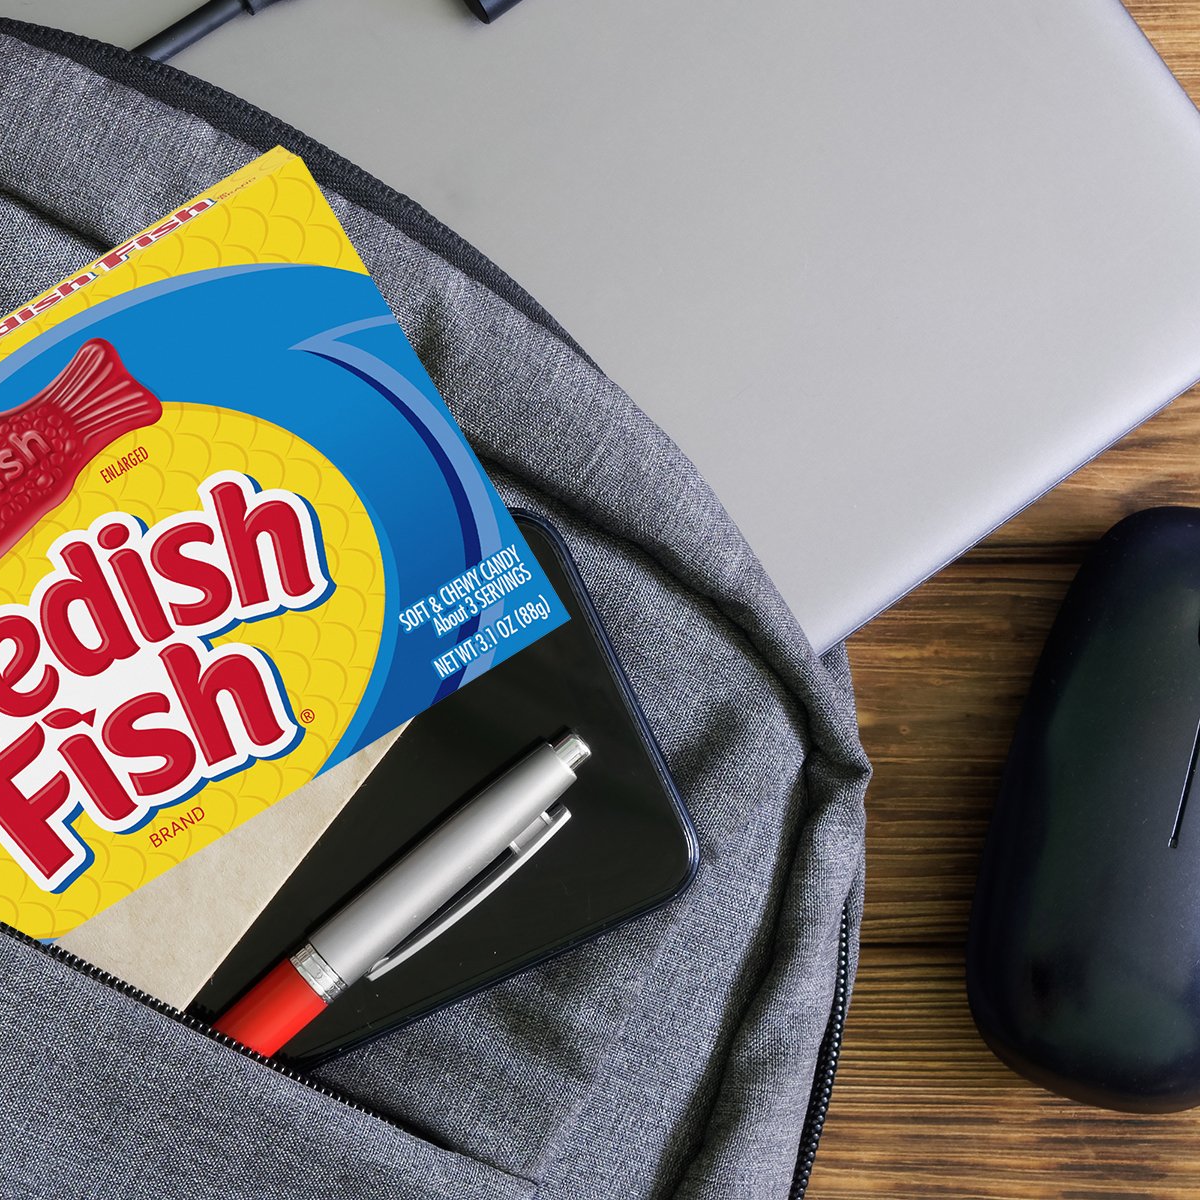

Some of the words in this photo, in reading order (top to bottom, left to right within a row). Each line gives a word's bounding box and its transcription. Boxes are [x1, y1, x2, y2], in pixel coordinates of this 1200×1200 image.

[93, 199, 215, 270] Fish
[99, 446, 149, 484] ENLARGED
[399, 600, 431, 632] SOFT
[428, 596, 444, 614] &
[439, 568, 483, 606] CHEWY
[480, 544, 521, 581] CANDY
[433, 604, 468, 636] About
[465, 596, 478, 615] 3
[474, 562, 532, 609] SERVINGS
[433, 650, 460, 678] NET
[454, 639, 478, 664] WT
[475, 628, 498, 651] 3.1
[496, 615, 519, 638] OZ
[514, 594, 551, 628] (88g)
[149, 806, 205, 848] BRAND
